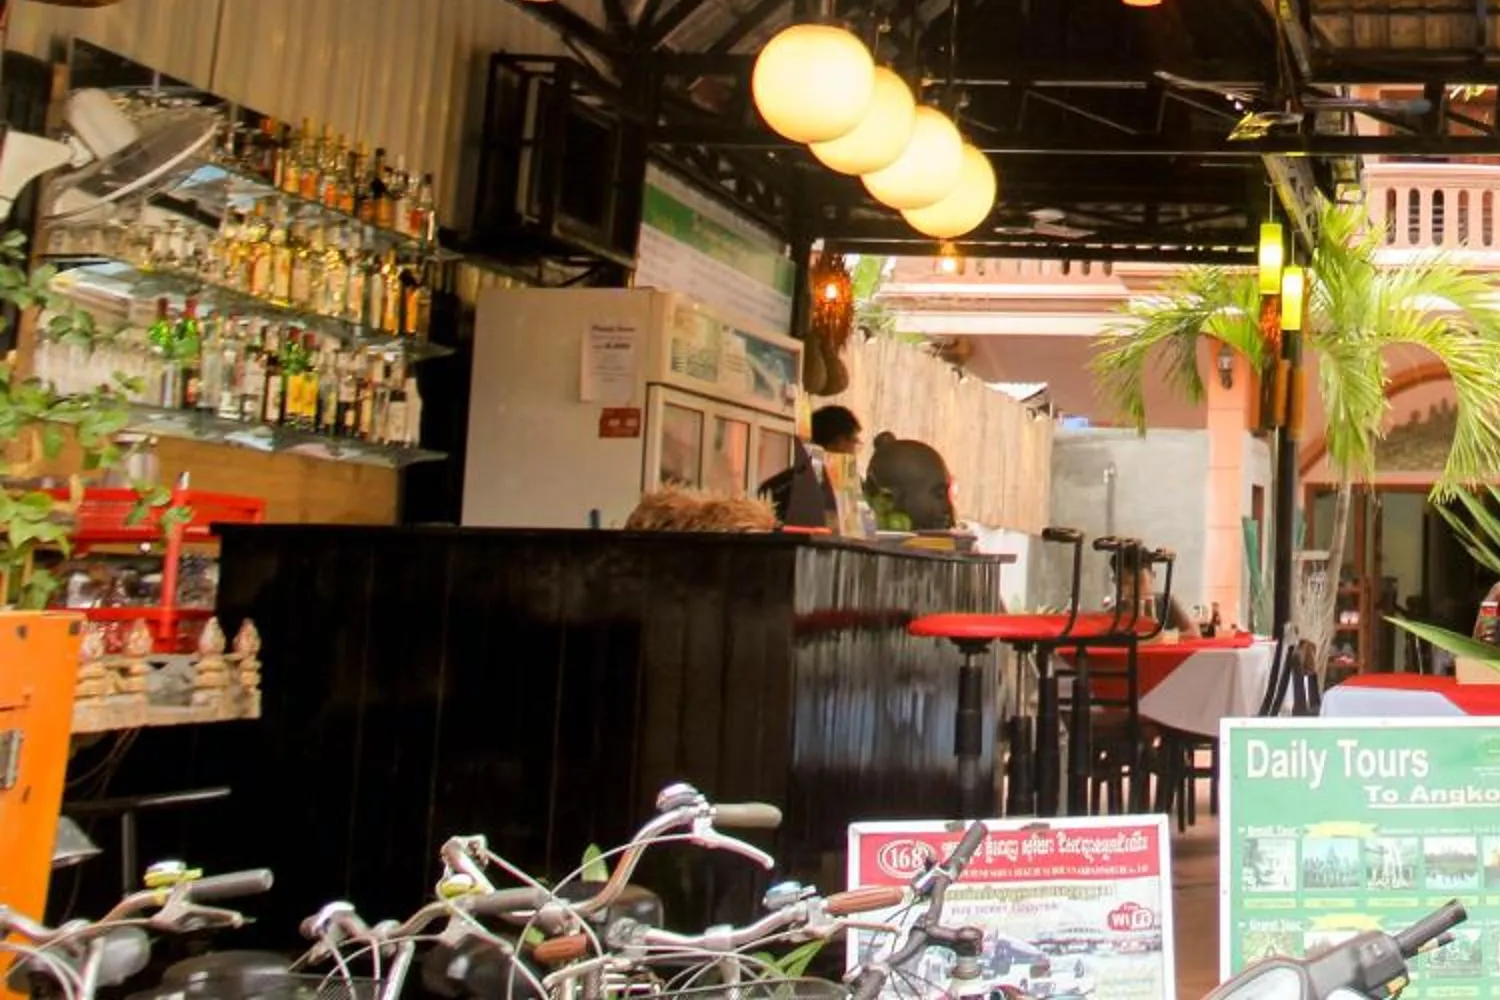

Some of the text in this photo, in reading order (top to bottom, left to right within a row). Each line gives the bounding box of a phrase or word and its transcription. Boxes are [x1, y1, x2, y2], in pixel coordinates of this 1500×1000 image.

[1246, 738, 1429, 789] Daily Tours
[1364, 785, 1398, 804] To
[891, 846, 924, 869] 168
